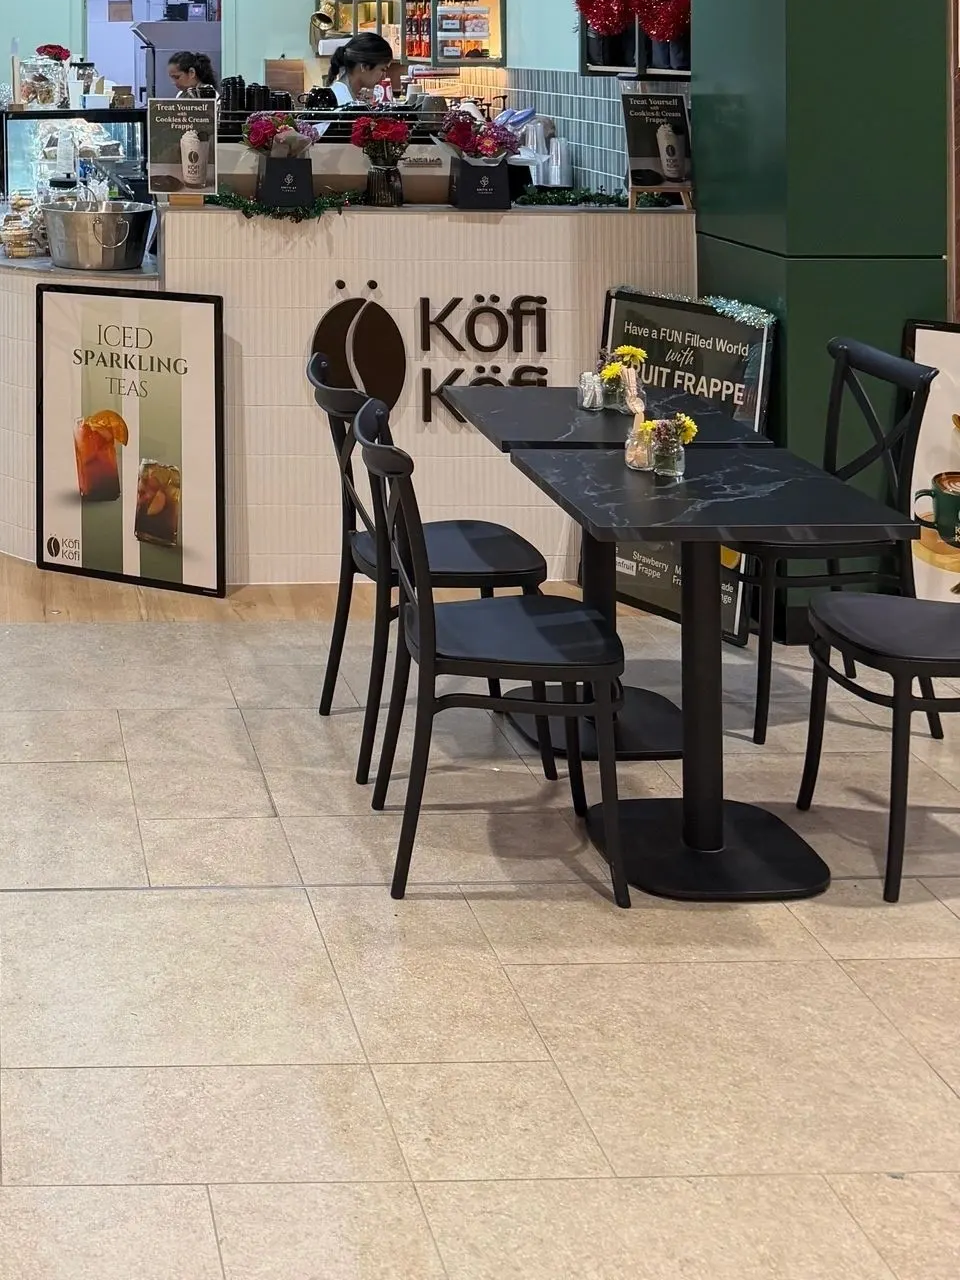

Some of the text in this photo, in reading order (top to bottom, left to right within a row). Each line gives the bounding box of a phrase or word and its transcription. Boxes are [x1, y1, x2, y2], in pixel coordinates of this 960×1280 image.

[155, 103, 209, 111] Treat Yourself
[629, 97, 679, 106] Treat Yourself
[419, 294, 548, 353] Köfi
[97, 324, 153, 350] ICED
[624, 321, 750, 357] Have a FUN Filled World
[72, 348, 188, 376] SPARKLING
[665, 347, 695, 368] with
[105, 376, 148, 398] TEAS
[629, 360, 746, 406] RUIT FRAPPE
[632, 550, 669, 573] Strawberry
[638, 563, 661, 579] Frappe
